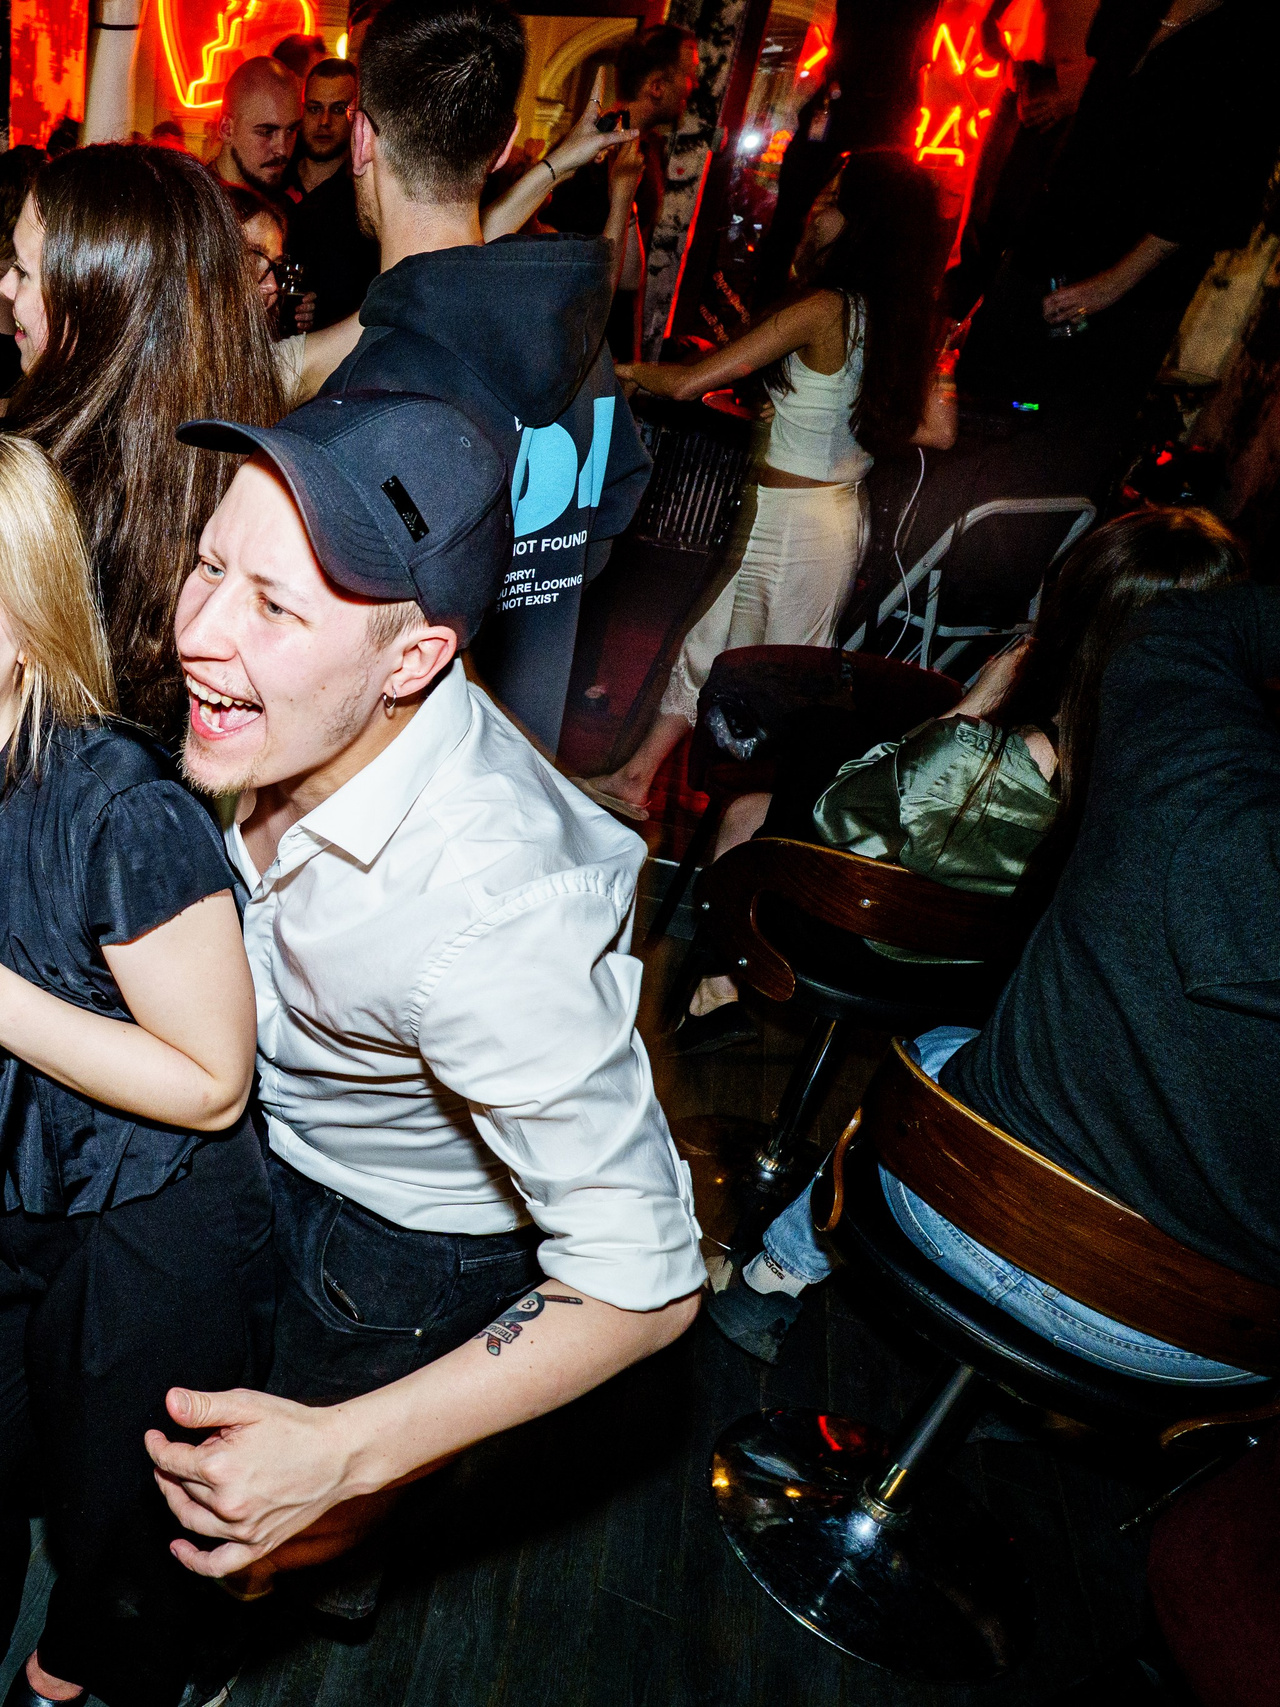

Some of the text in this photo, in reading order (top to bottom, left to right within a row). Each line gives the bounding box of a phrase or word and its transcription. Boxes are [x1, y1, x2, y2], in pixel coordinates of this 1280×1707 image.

[541, 530, 588, 552] FOUND
[508, 582, 532, 596] ARE
[534, 574, 583, 592] LOOKING
[502, 597, 524, 611] NOT
[525, 592, 559, 606] EXIST
[521, 1299, 536, 1310] 8
